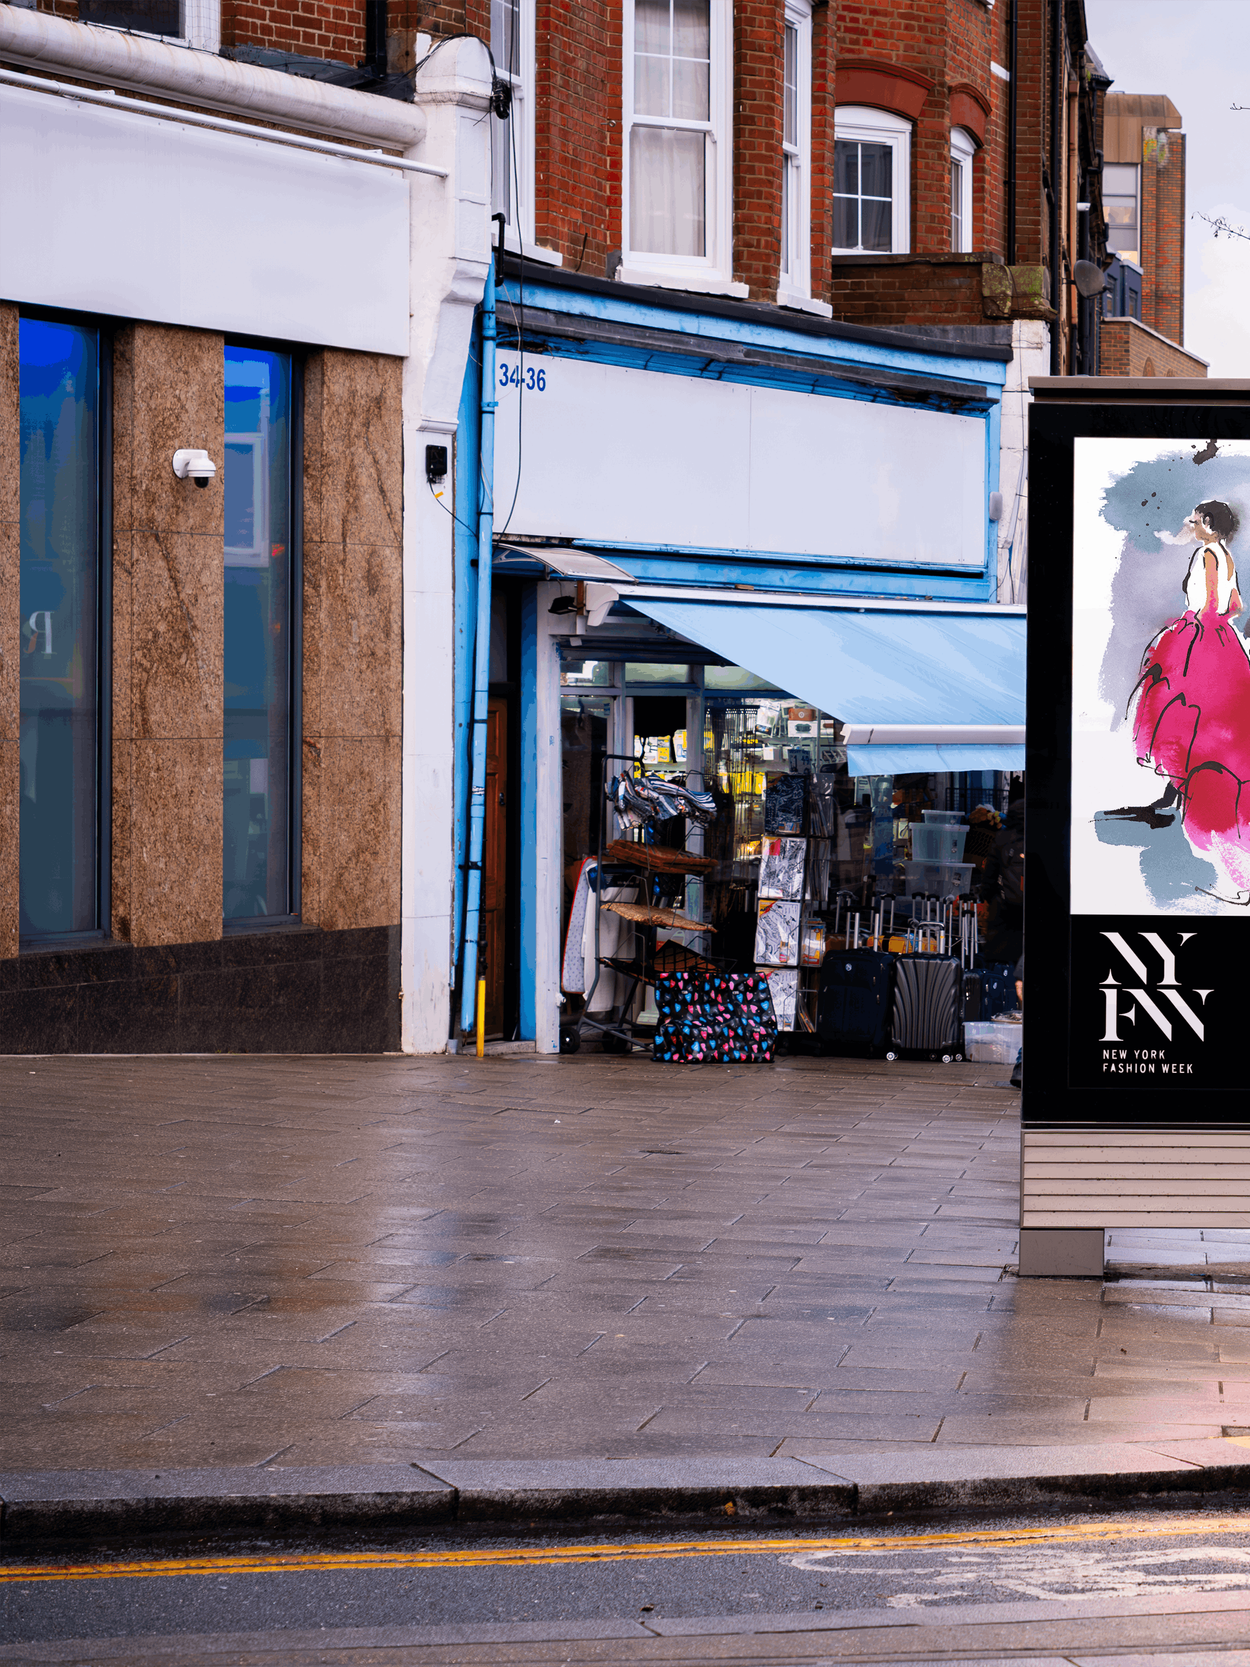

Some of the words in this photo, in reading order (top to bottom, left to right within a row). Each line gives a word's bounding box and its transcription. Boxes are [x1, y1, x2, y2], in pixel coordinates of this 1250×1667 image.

[498, 363, 546, 392] 34-36
[1102, 1049, 1128, 1060] NEW
[1133, 1049, 1166, 1060] YORK
[1102, 1063, 1156, 1074] FASHION
[1161, 1063, 1194, 1074] WEEK
